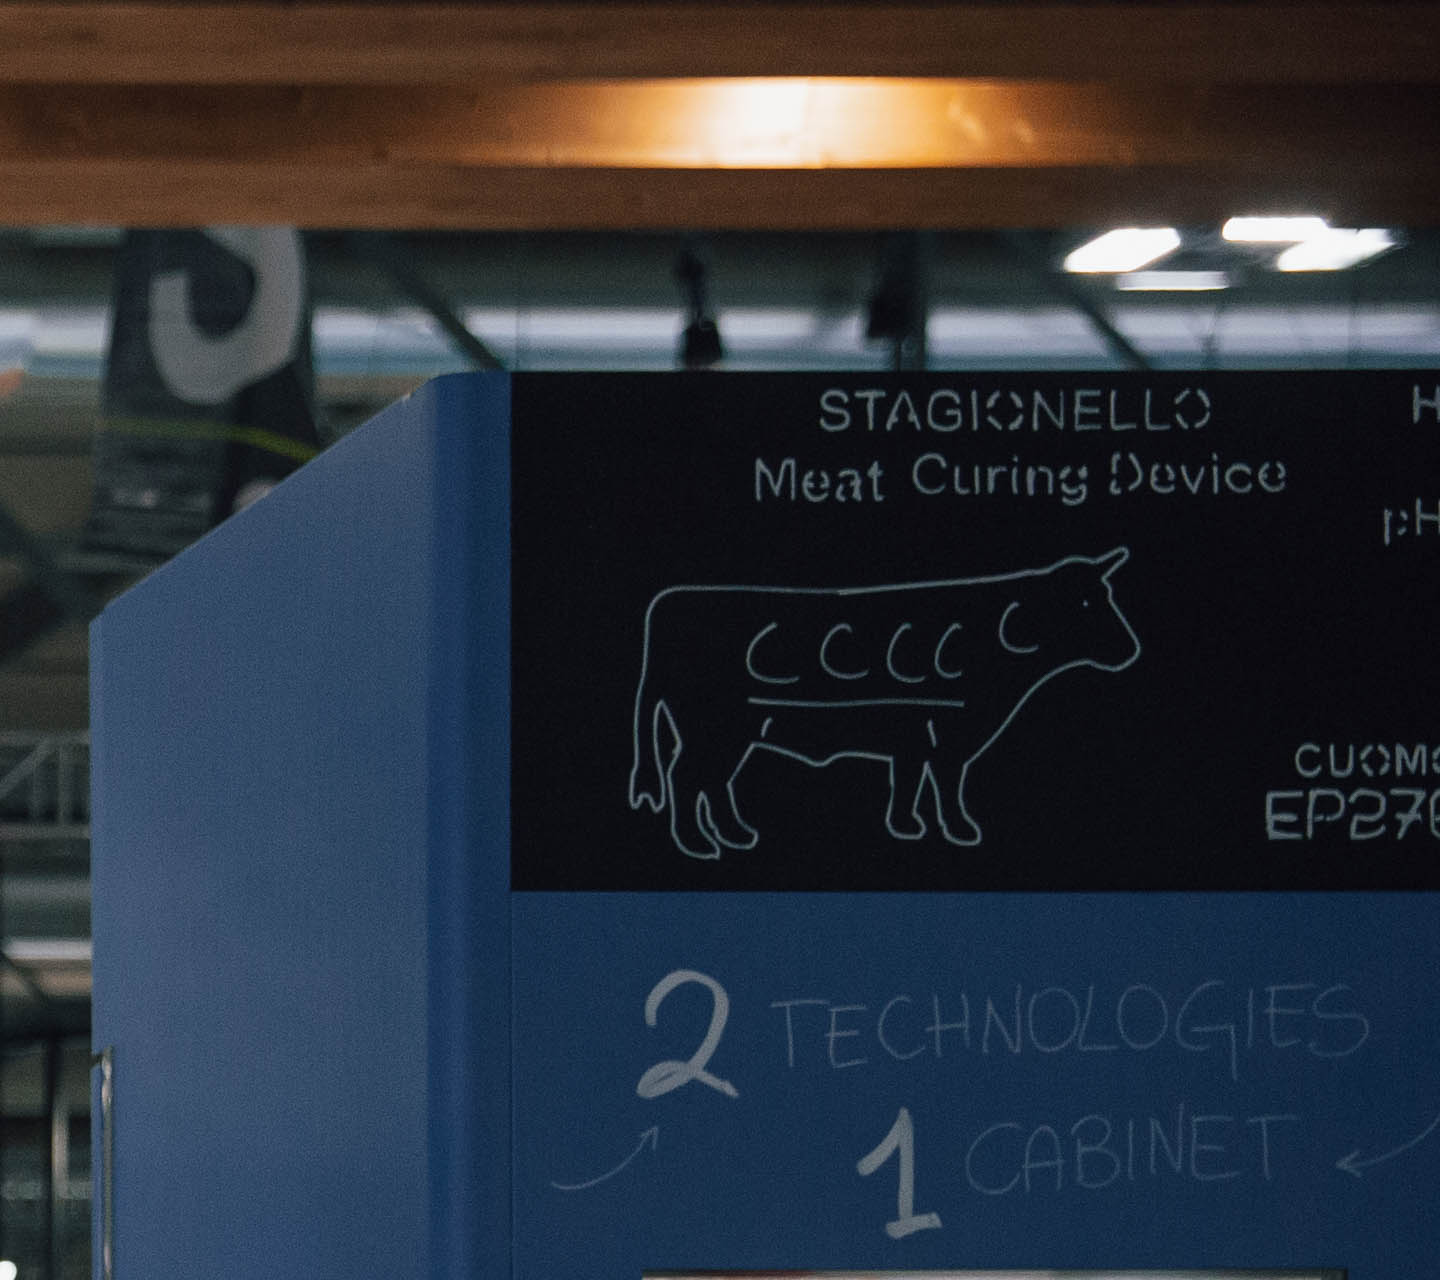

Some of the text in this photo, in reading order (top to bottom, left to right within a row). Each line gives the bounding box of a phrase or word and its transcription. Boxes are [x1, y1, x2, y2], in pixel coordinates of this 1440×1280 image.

[818, 388, 1212, 433] STAGIONELLO
[753, 452, 1288, 507] Meat Curing Device
[635, 968, 1372, 1100] 2 TECHNOLOGIES
[855, 1100, 1300, 1239] 1 CABINET
